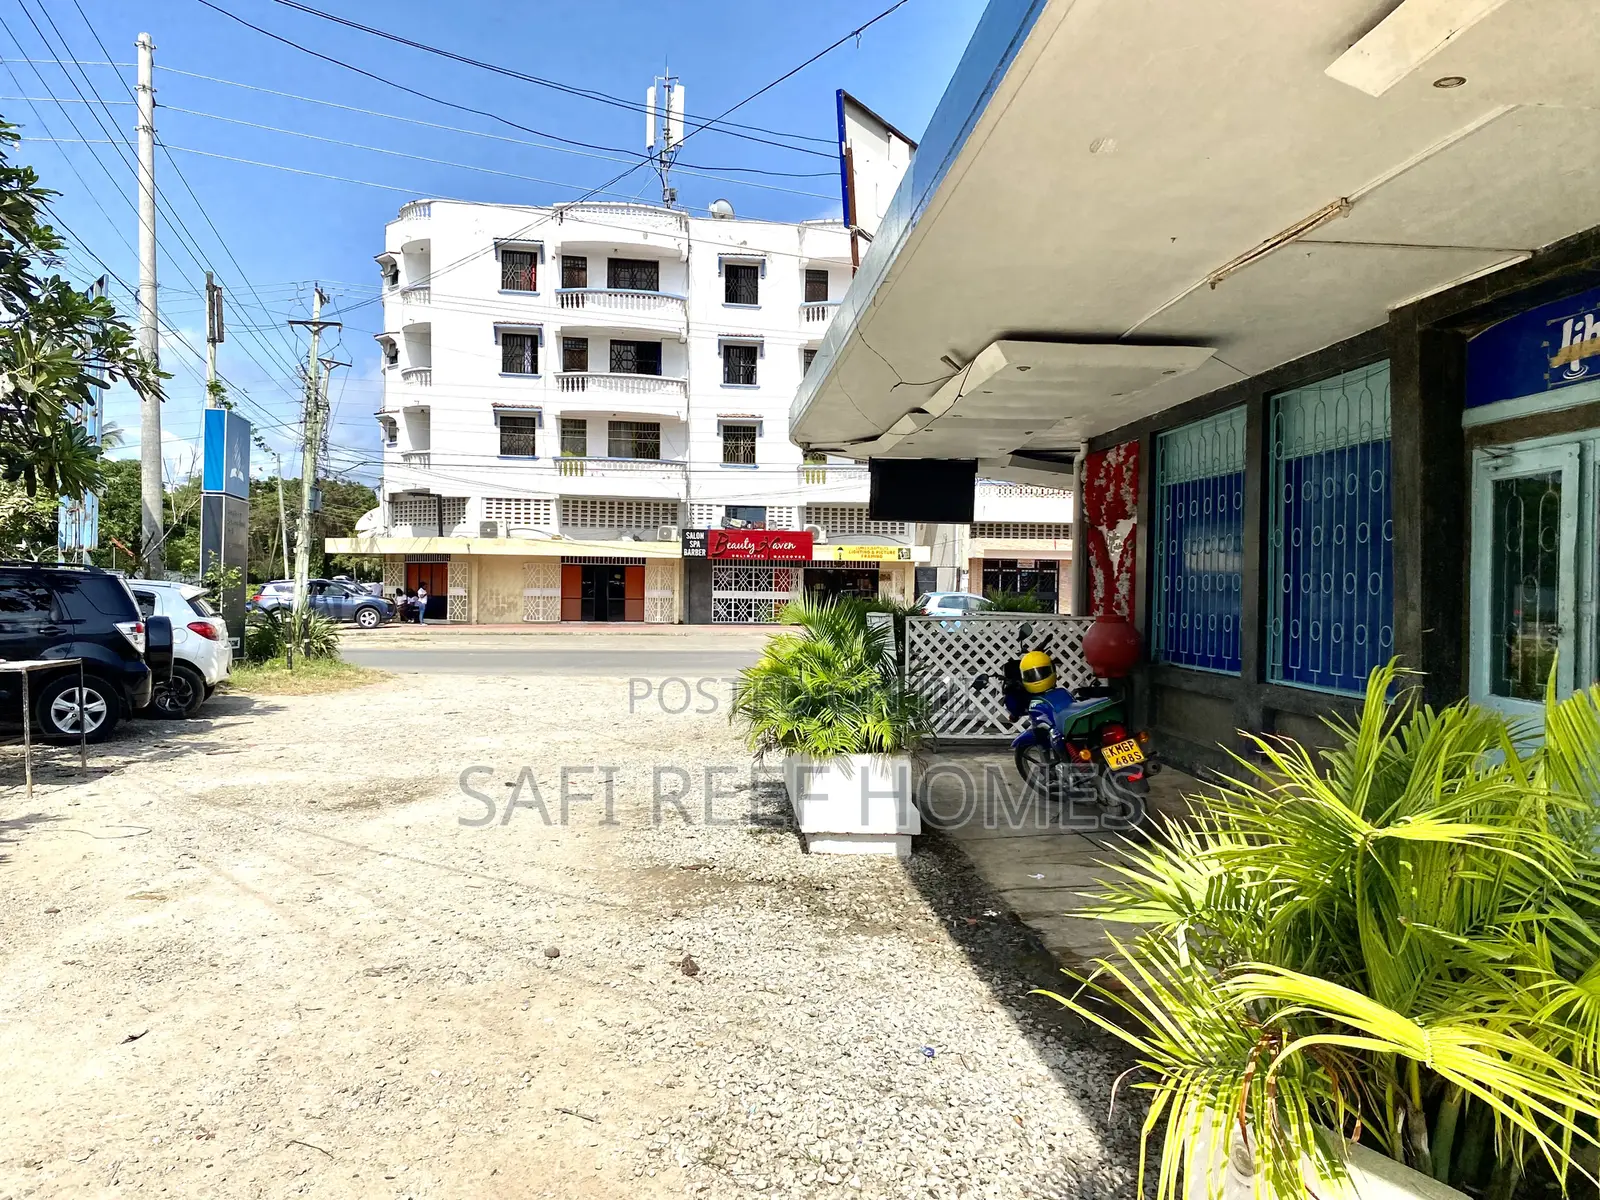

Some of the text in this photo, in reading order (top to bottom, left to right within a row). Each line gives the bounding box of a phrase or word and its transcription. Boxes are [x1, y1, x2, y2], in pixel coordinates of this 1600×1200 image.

[685, 532, 705, 540] SALON
[712, 532, 796, 559] Beauty Haven
[683, 549, 706, 557] BARBER
[1115, 752, 1142, 766] 488S
